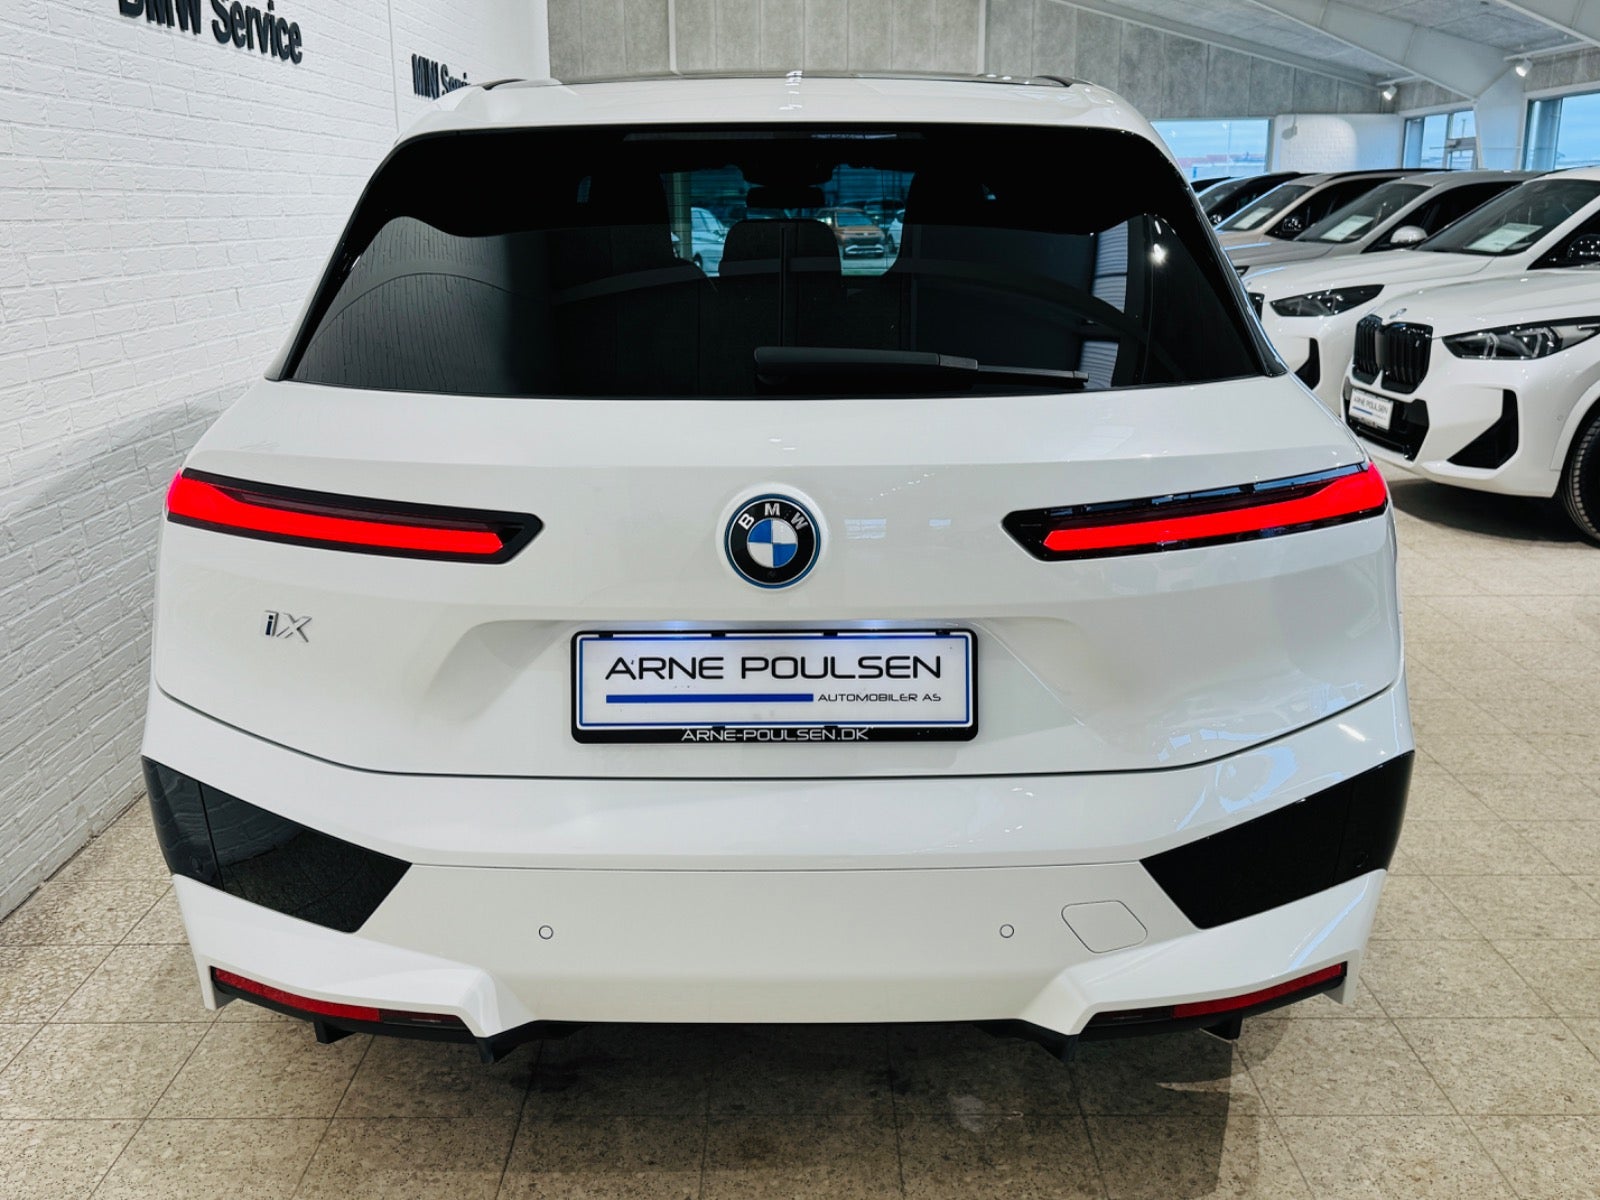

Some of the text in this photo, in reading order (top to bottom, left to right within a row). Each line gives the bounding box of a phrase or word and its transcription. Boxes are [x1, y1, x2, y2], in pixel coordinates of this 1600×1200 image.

[211, 0, 303, 65] Service
[737, 502, 809, 531] BMW
[605, 655, 941, 681] ARNE POULSEN
[817, 693, 942, 702] AUTOMOBILER AS
[681, 727, 869, 742] ARNE-POULSEN.DK
